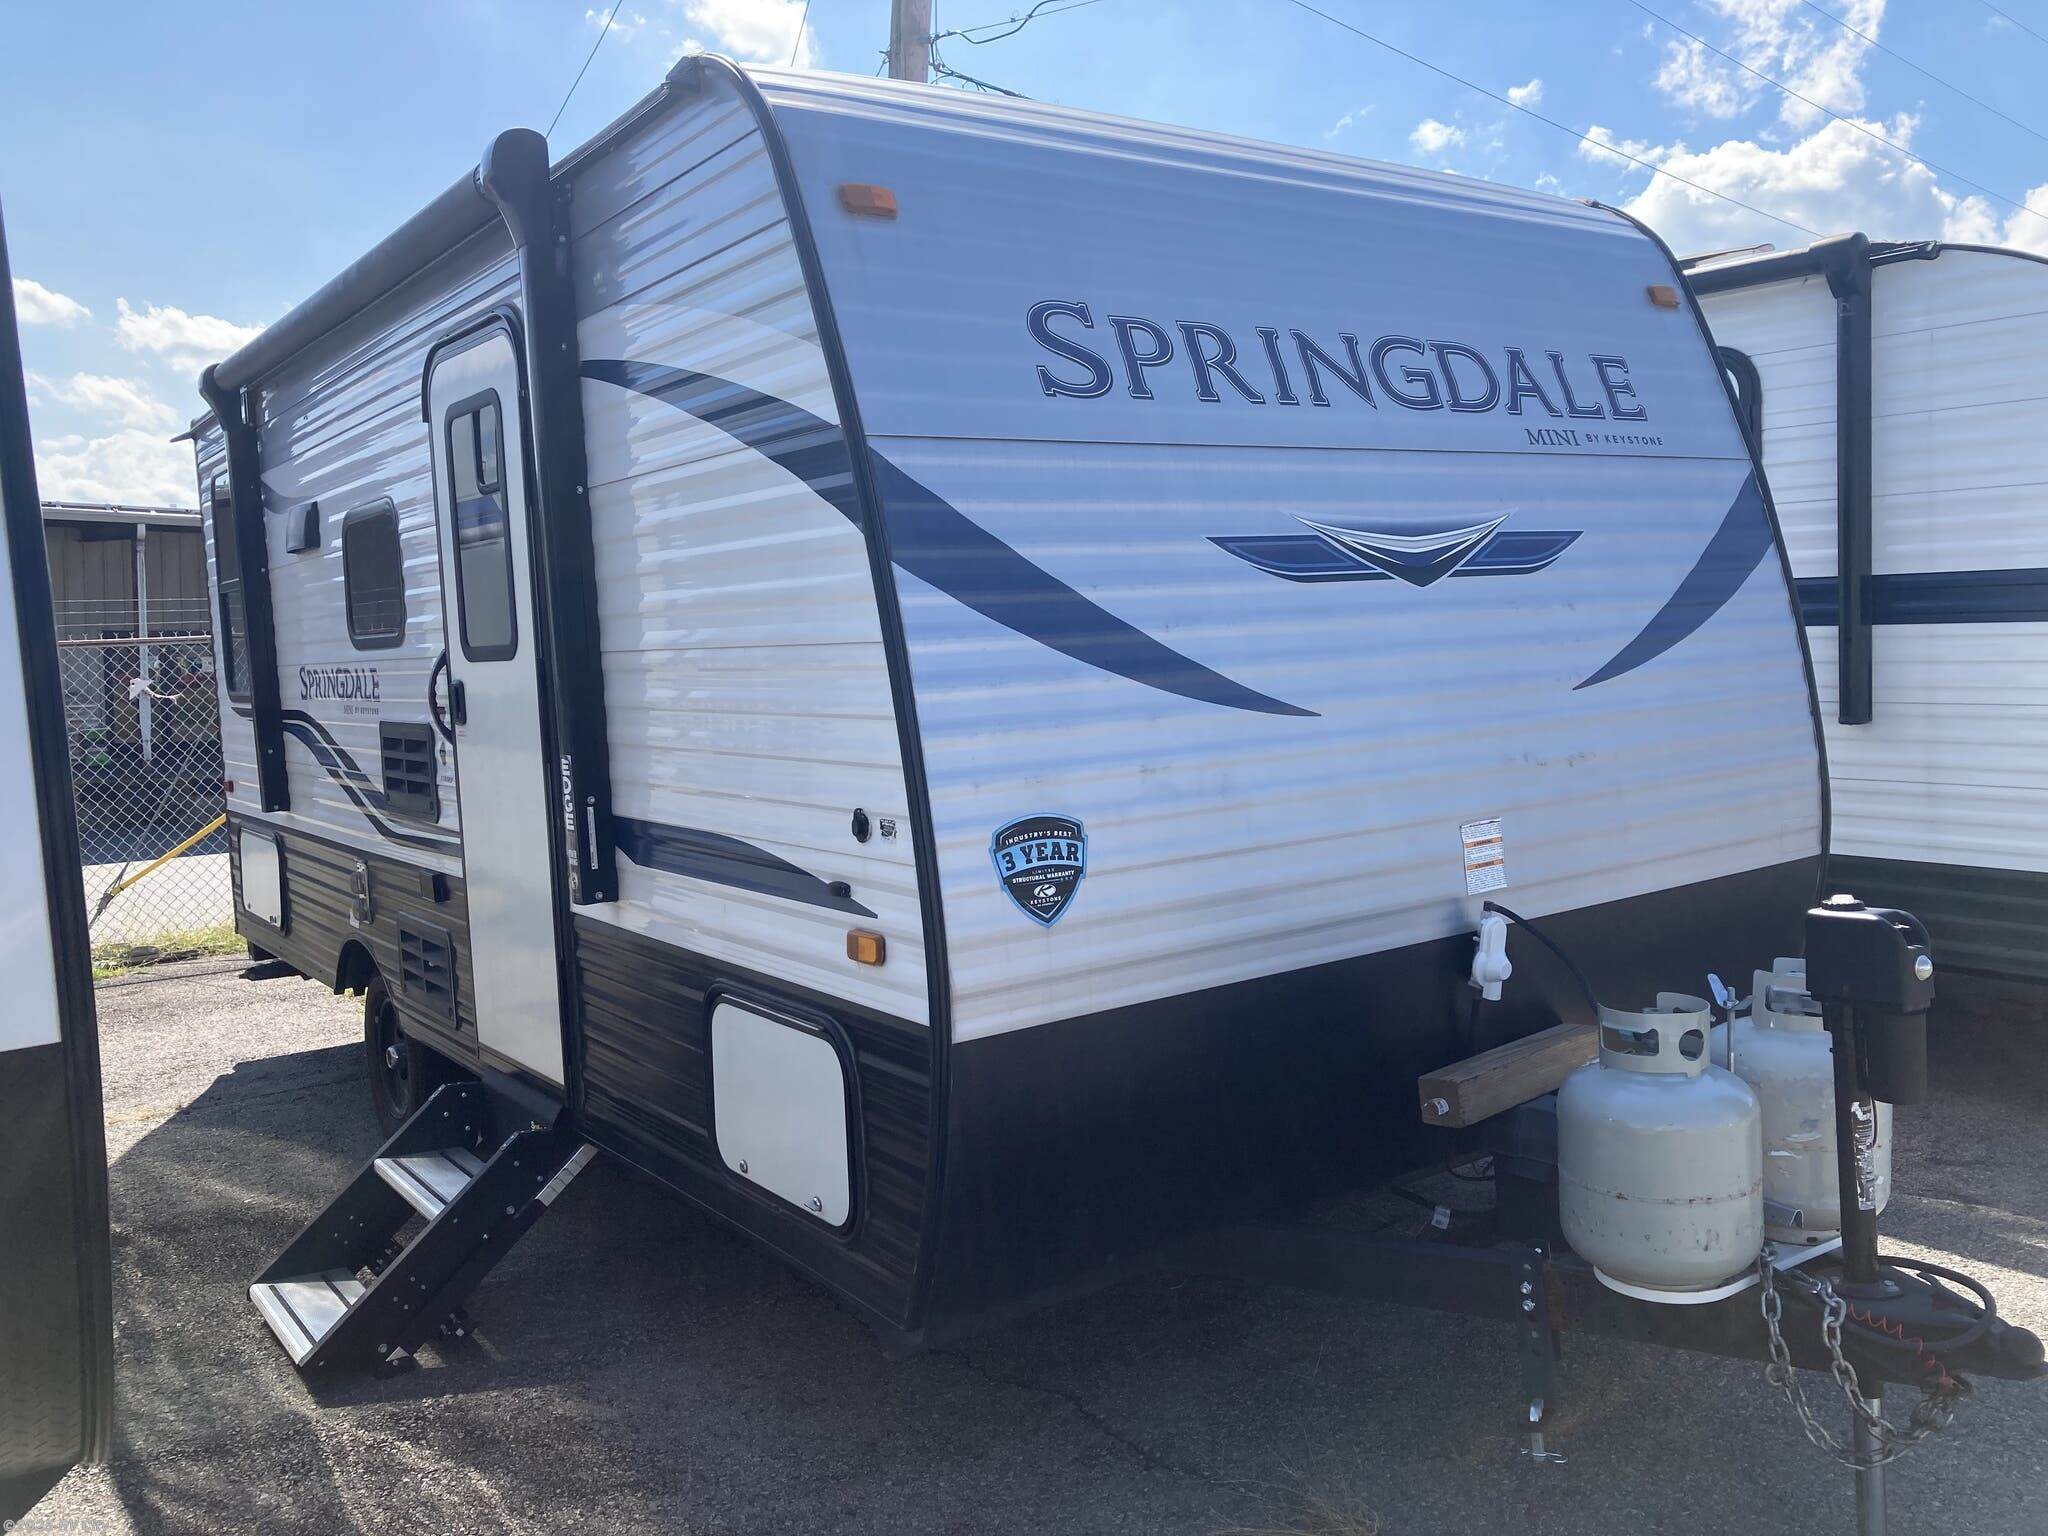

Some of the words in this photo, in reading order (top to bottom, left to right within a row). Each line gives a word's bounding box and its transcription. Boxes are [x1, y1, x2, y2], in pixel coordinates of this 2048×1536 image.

[1026, 300, 1648, 422] SPRINGDALE
[1524, 428, 1582, 446] MINI
[1585, 433, 1600, 444] BY
[1605, 433, 1664, 446] KEYSTONE
[299, 666, 380, 701] SPRINGDALE
[1005, 830, 1051, 846] INDUSTRY'S
[1001, 851, 1016, 872] 3
[1020, 842, 1080, 865] YEAR
[1012, 874, 1046, 884] STRUCTURAL
[1046, 870, 1075, 879] WARRANTY
[1030, 896, 1061, 905] KEYSTONE
